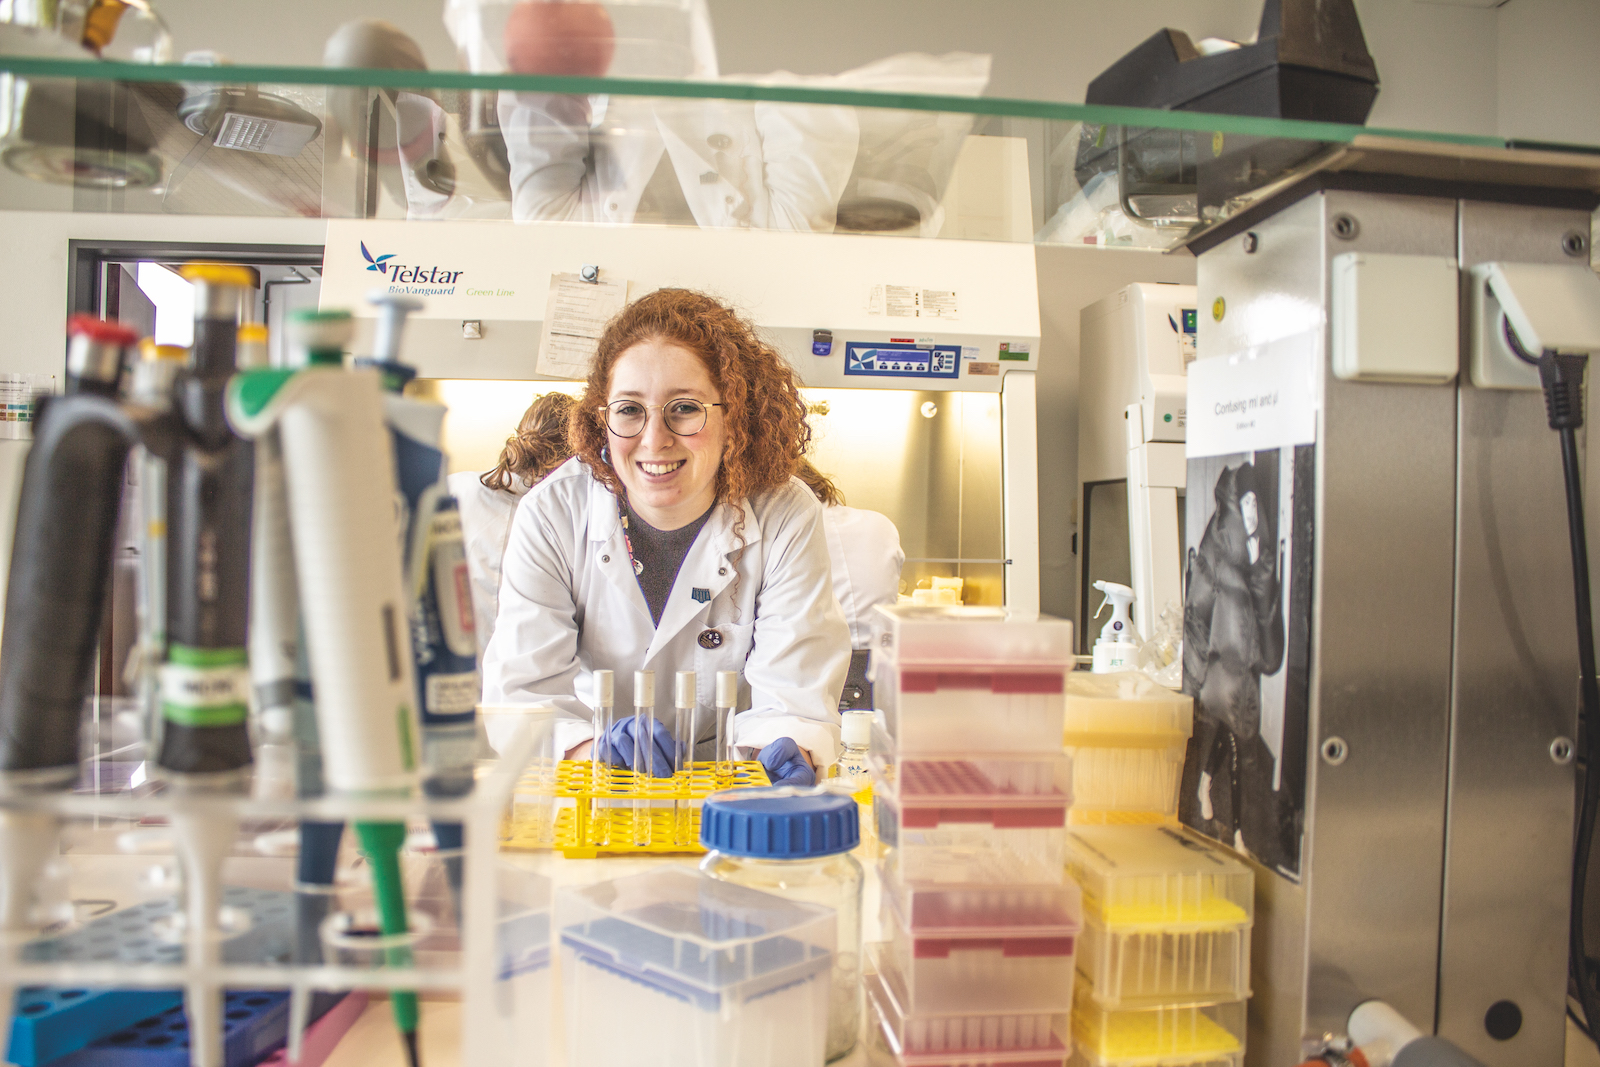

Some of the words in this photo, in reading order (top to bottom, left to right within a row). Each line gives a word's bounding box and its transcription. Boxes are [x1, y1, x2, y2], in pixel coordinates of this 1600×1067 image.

[388, 264, 464, 284] Telstar
[388, 285, 456, 297] BioVanguard
[466, 288, 494, 296] Green
[496, 288, 515, 297] Line
[1214, 399, 1247, 416] Confusing
[1259, 391, 1272, 407] and
